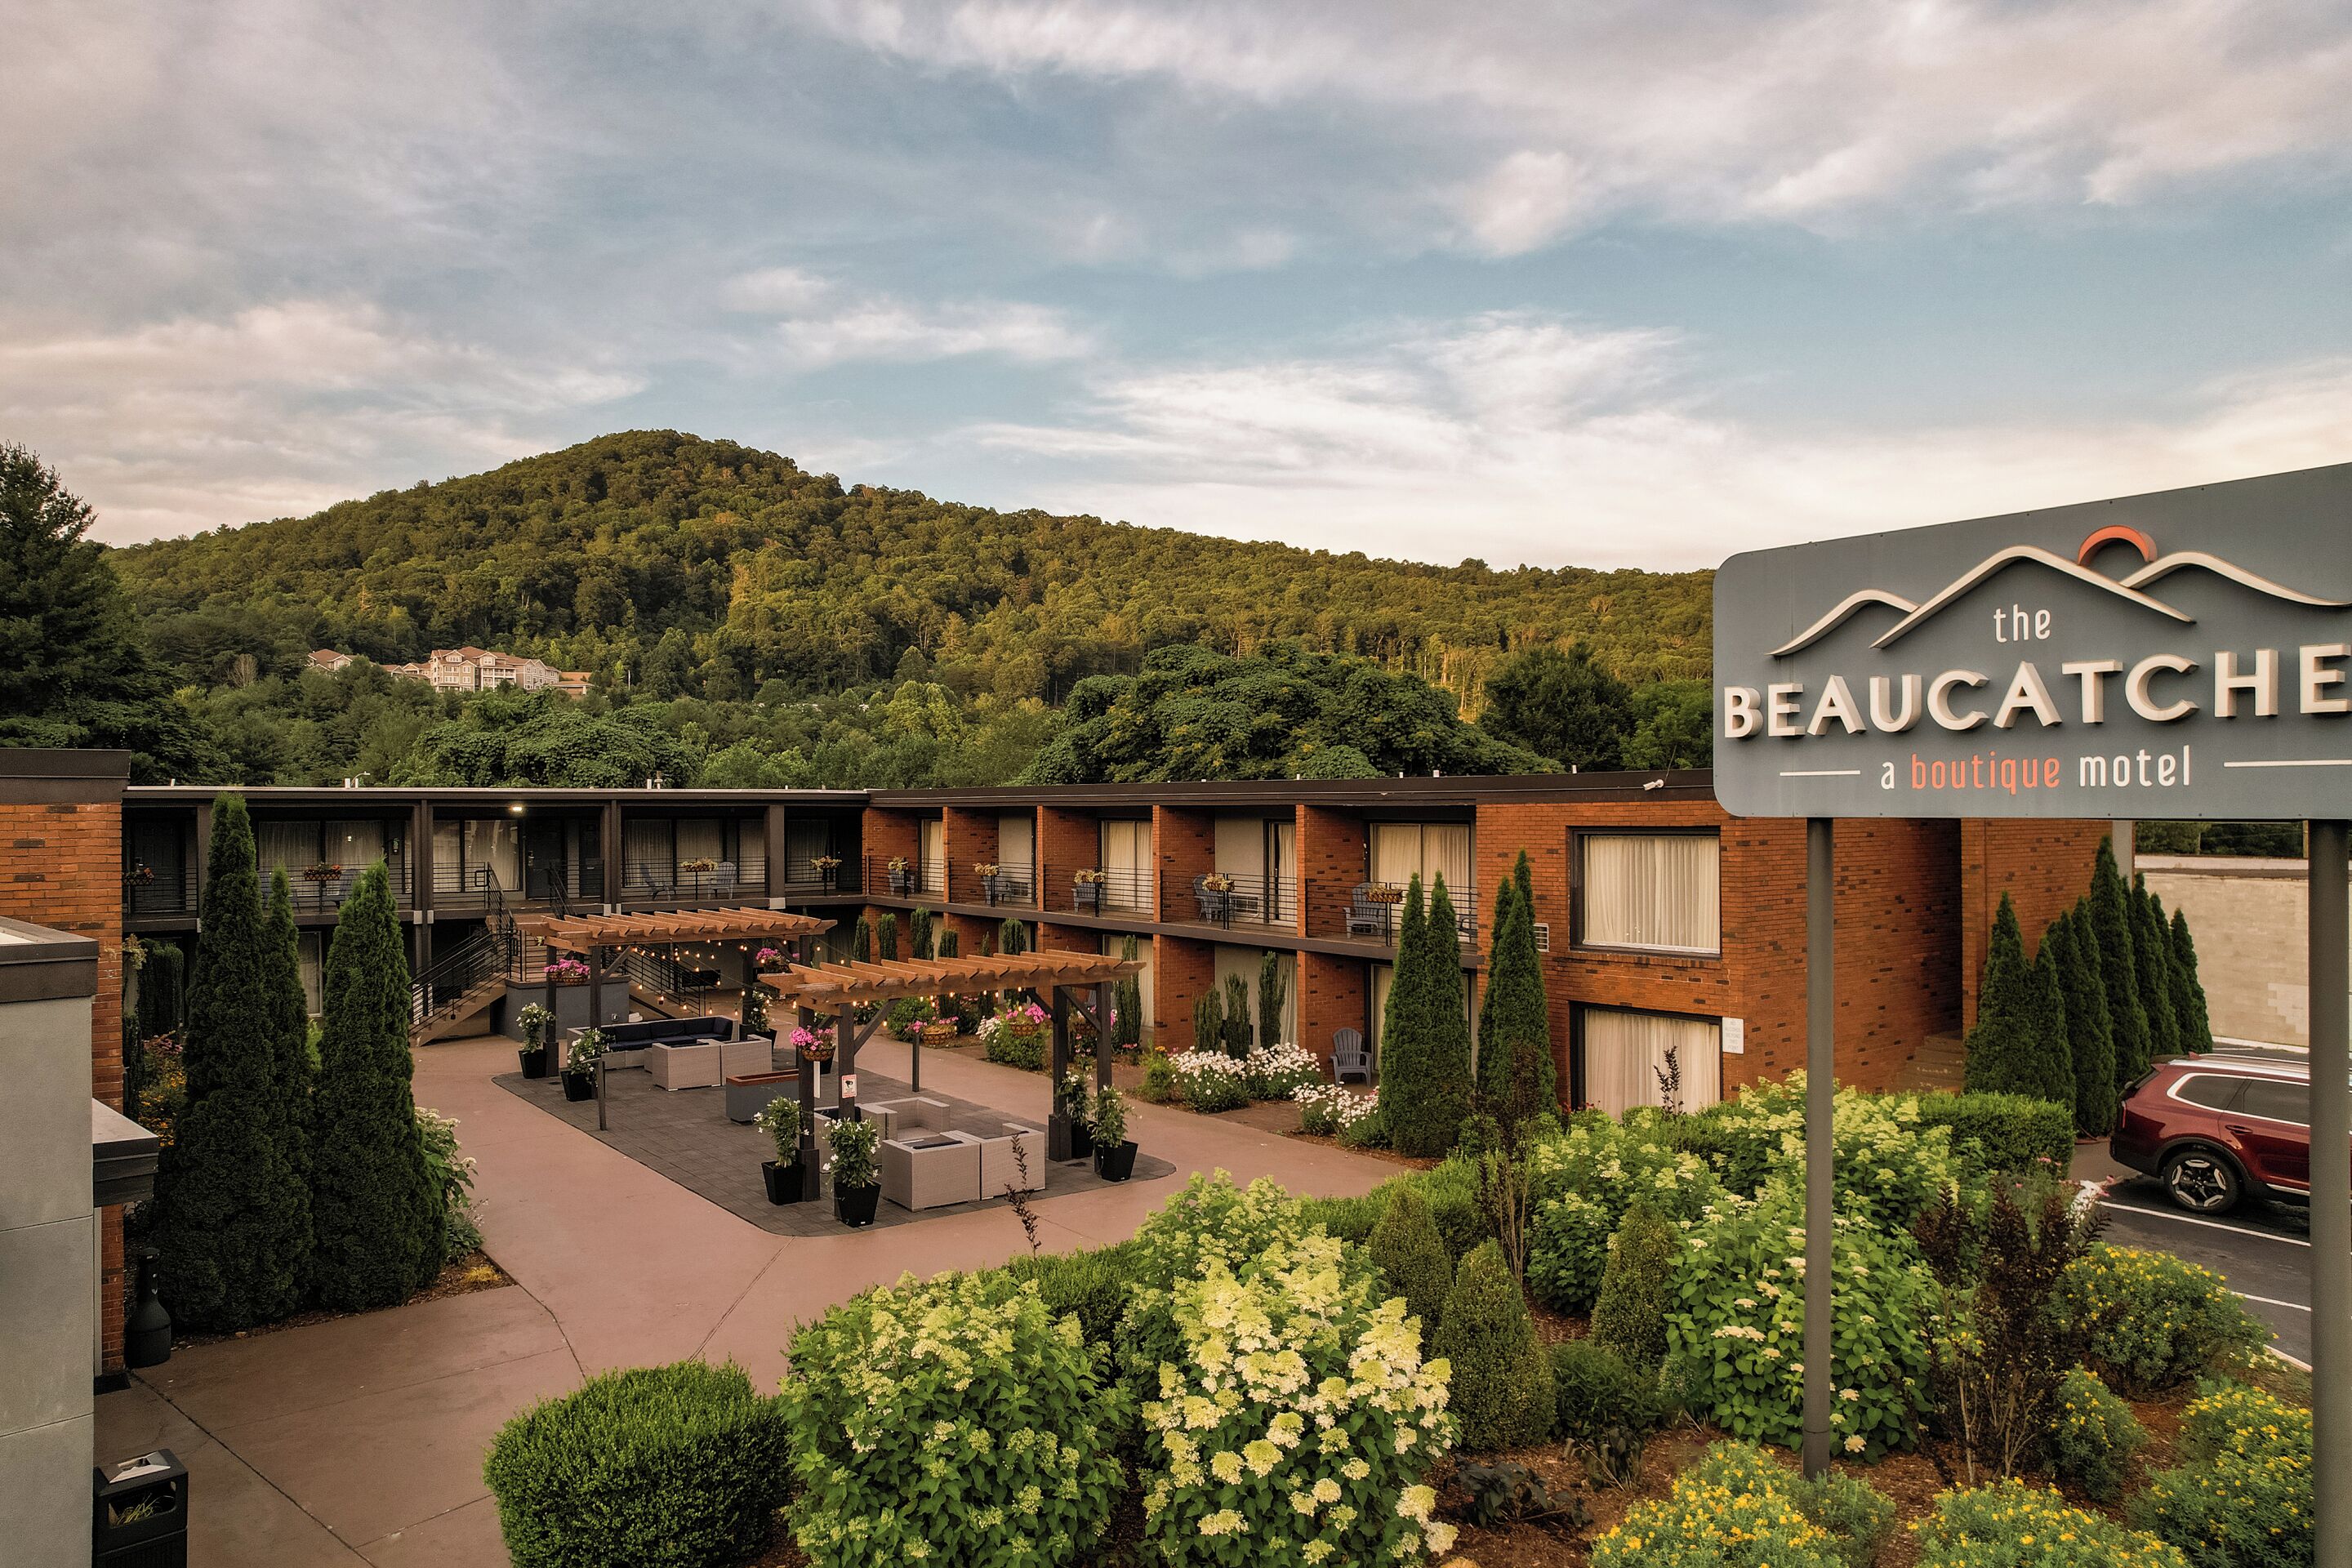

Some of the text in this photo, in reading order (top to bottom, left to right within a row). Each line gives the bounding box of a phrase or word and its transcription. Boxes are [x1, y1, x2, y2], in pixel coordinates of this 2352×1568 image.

[1993, 604, 2051, 644] the
[1723, 643, 2352, 739] BEAUCATCHE
[1880, 744, 2191, 796] a boutique motel
